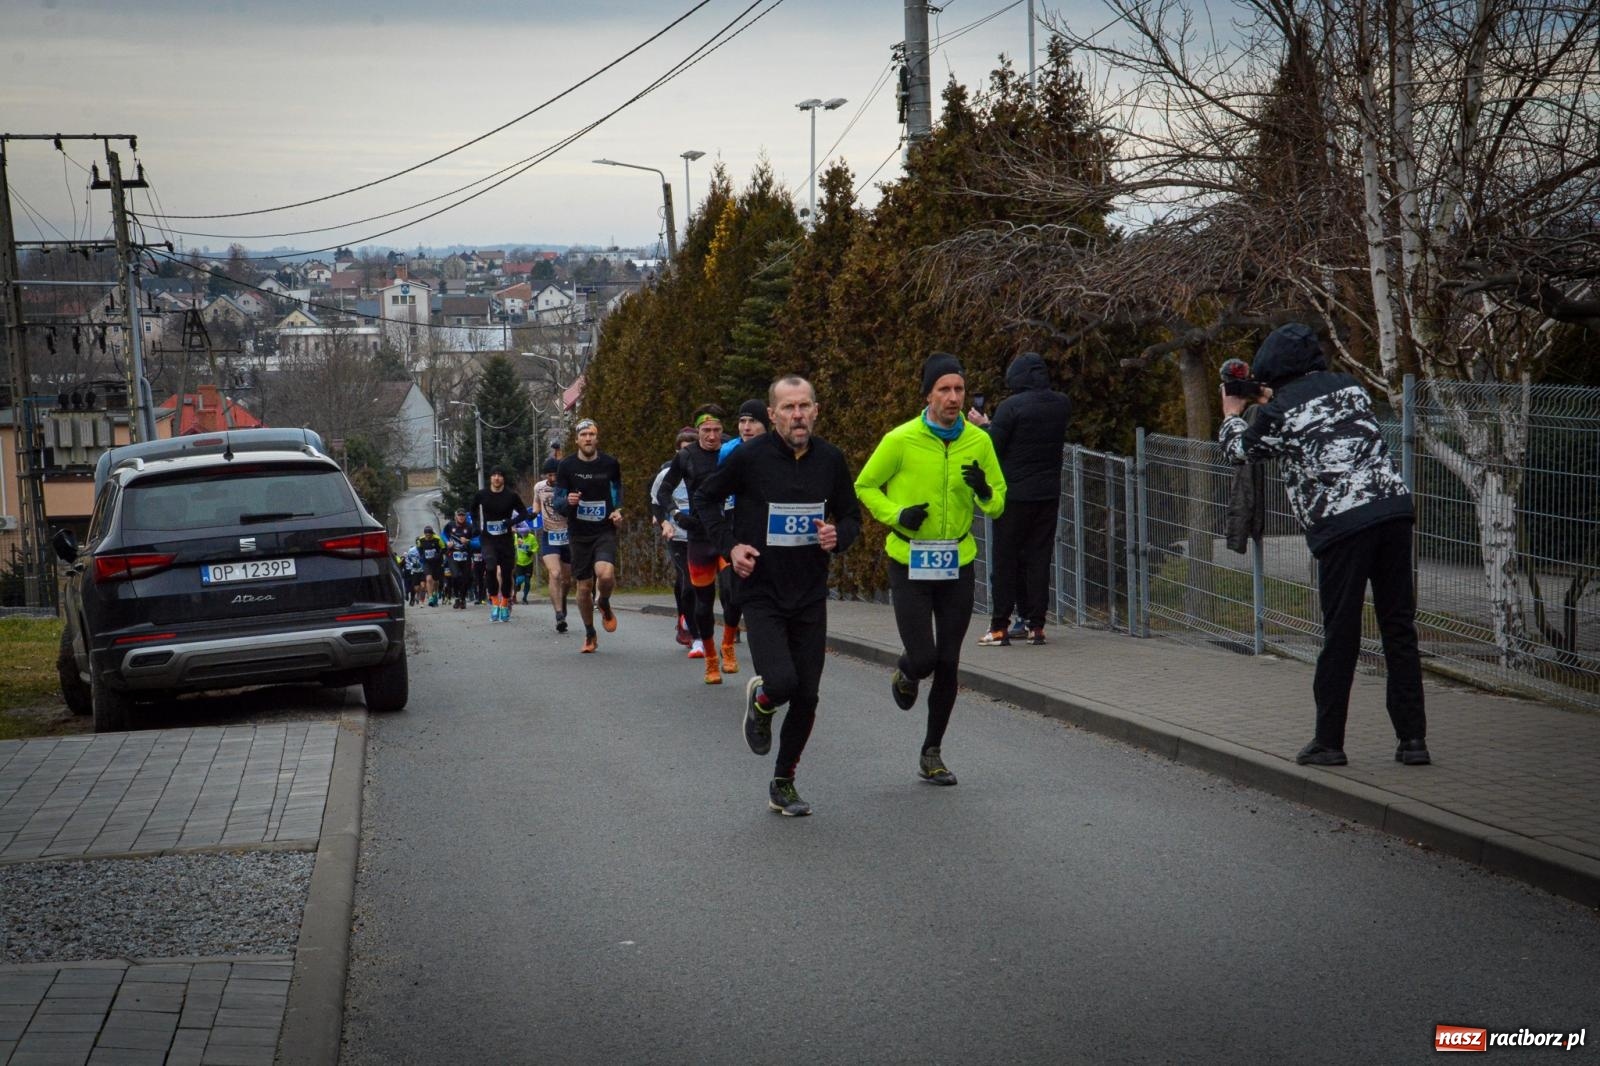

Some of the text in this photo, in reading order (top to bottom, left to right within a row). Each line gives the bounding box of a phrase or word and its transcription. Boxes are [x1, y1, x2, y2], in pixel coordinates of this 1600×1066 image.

[582, 507, 601, 516] 126
[784, 515, 810, 534] 83
[919, 551, 953, 568] 139
[212, 560, 291, 581] OP 1239P
[231, 594, 276, 604] Ateca
